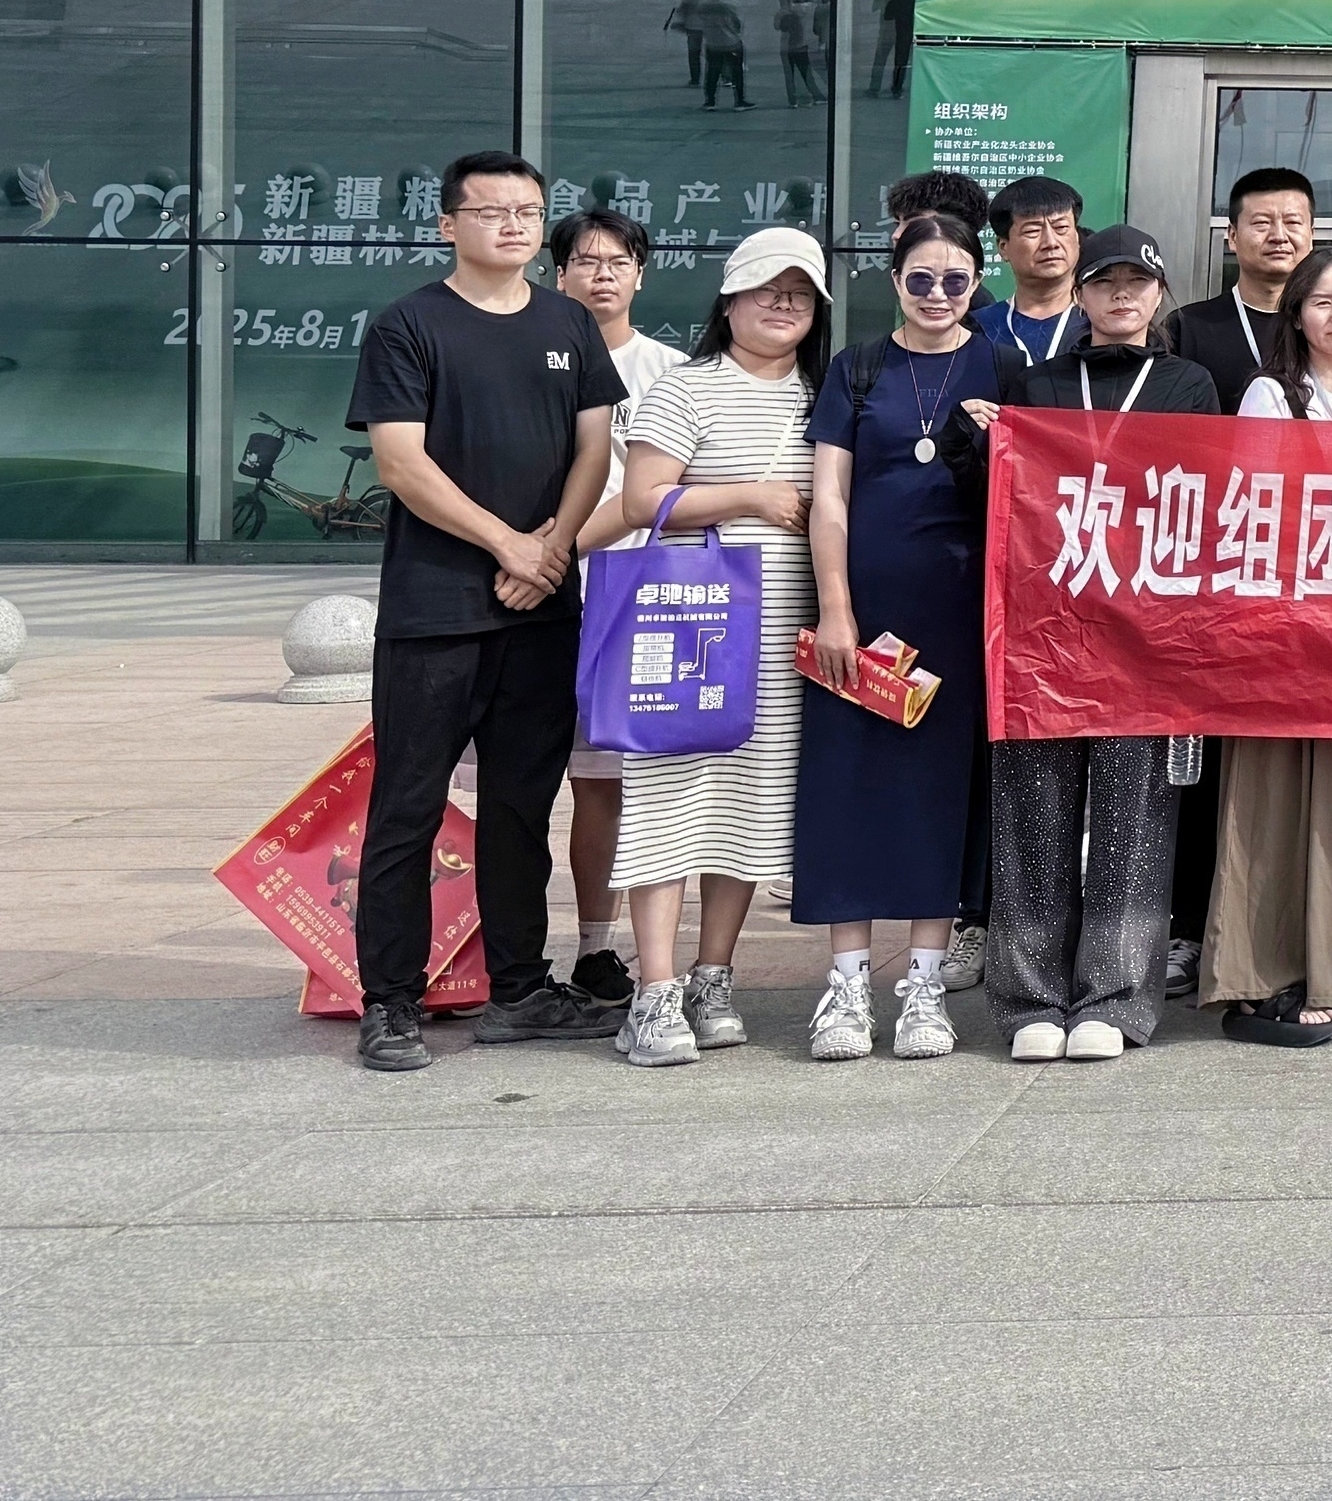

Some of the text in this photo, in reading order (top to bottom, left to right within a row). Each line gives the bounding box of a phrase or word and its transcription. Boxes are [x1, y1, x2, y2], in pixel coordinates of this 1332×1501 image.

[934, 102, 1008, 120] 组织架构
[636, 583, 730, 605] 卓驰输送
